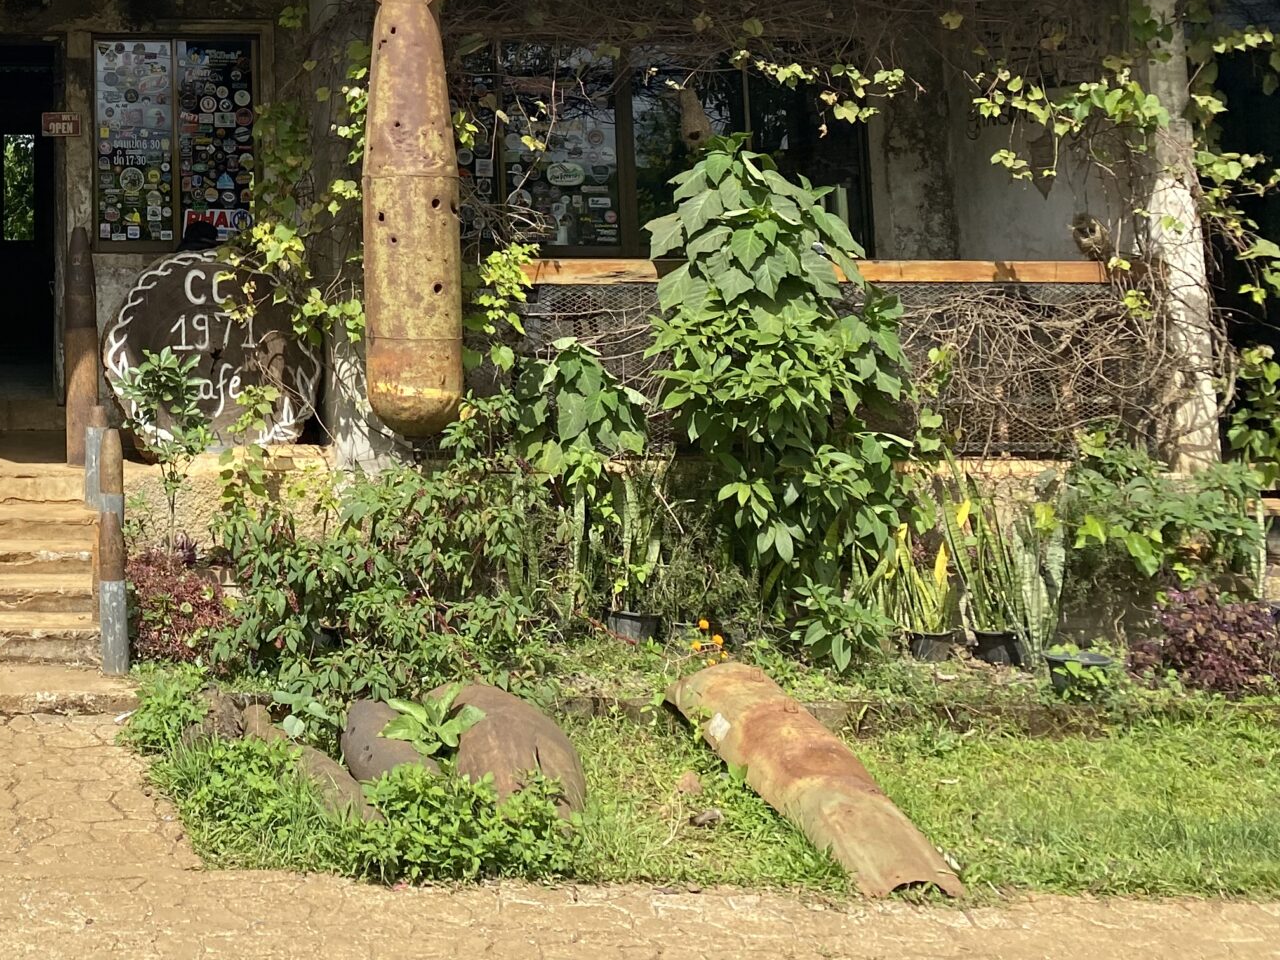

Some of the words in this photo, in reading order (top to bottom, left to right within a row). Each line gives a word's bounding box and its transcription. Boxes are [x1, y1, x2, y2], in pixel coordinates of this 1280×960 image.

[48, 122, 73, 134] OPEN
[184, 269, 236, 305] CC
[170, 311, 257, 351] 1971
